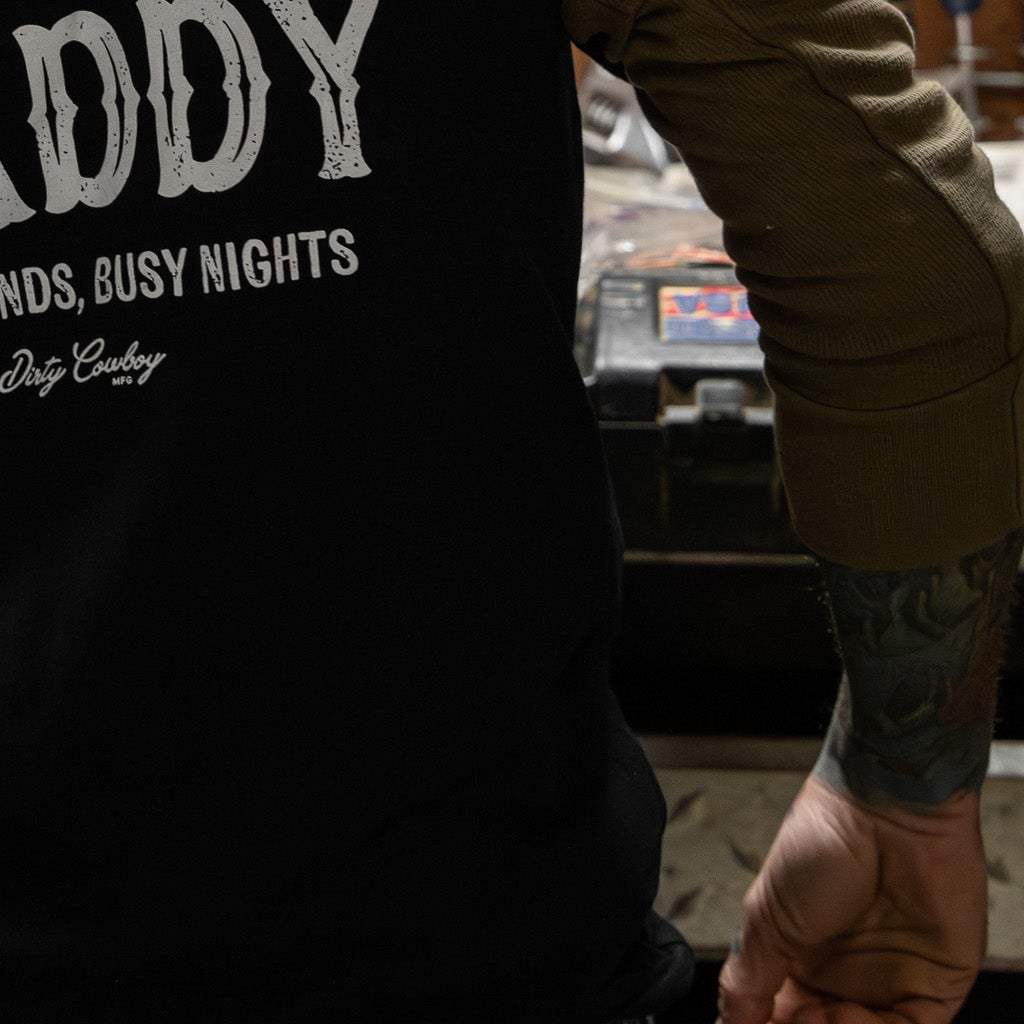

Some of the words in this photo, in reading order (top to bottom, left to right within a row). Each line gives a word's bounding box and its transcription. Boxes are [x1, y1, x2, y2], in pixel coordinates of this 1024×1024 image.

[93, 247, 188, 304] BUSY
[199, 228, 359, 294] NIGHTS
[72, 337, 167, 385] Cowboy
[112, 376, 133, 386] MFG
